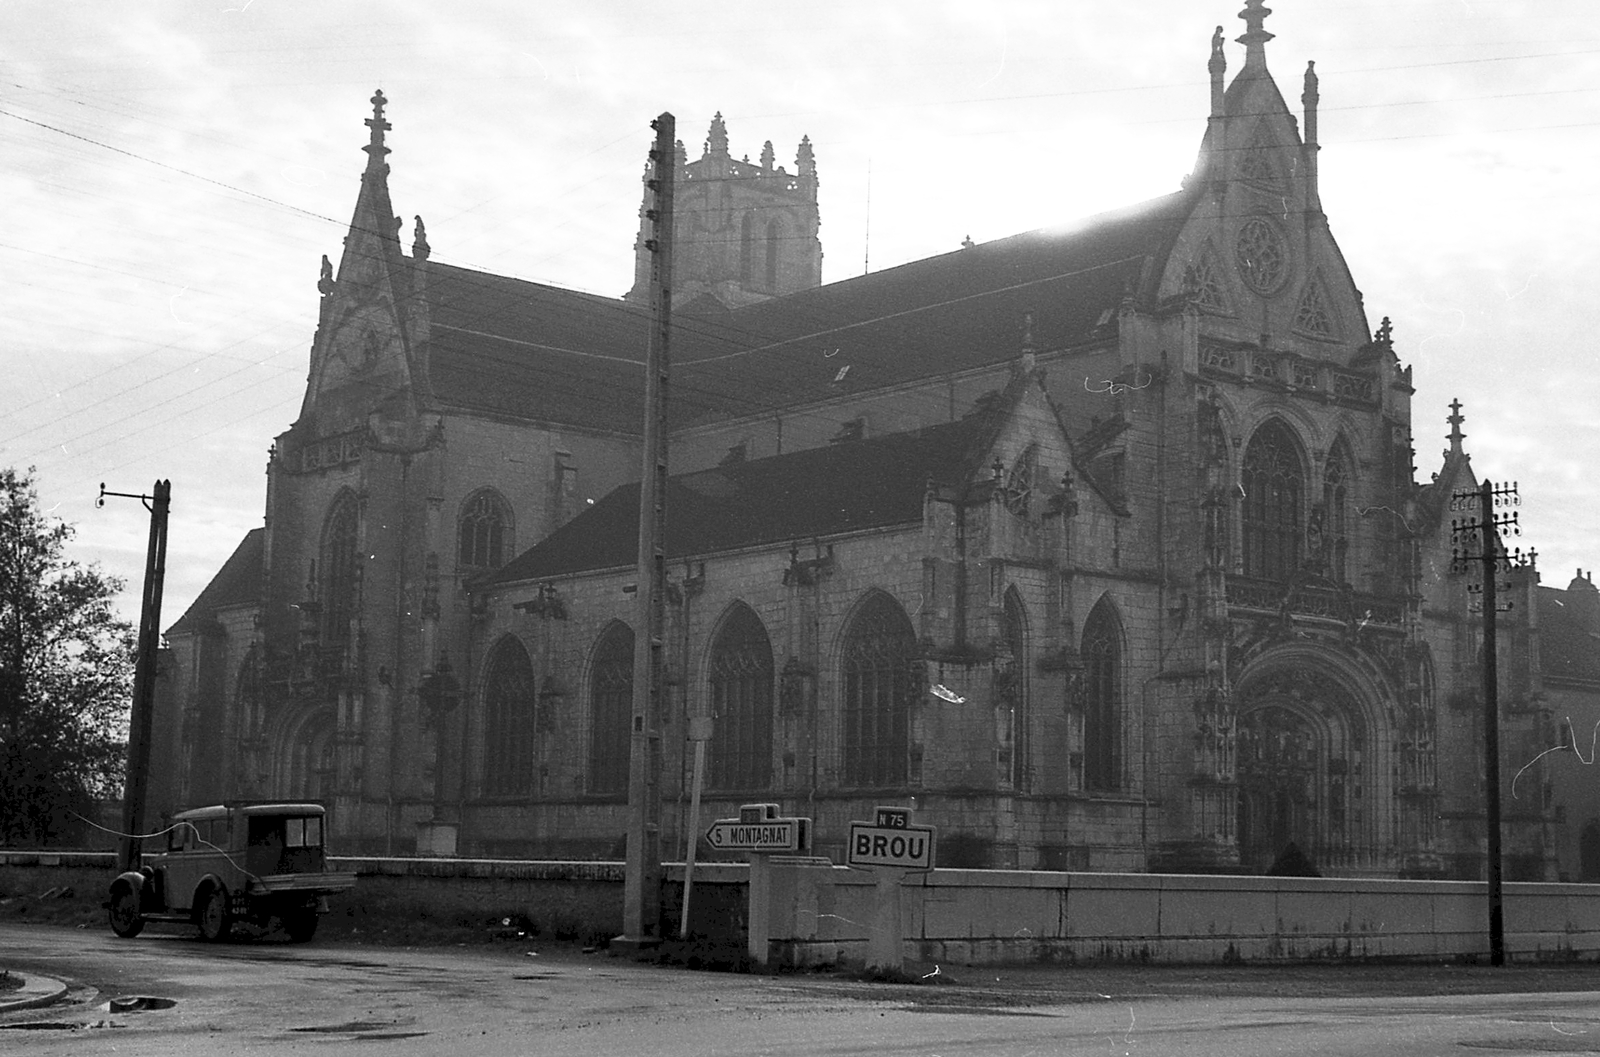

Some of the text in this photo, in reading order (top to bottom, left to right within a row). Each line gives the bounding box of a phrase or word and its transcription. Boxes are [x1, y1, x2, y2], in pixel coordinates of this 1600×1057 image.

[879, 814, 905, 827] N 75
[715, 826, 788, 844] 5 MONTAGNAT
[856, 833, 924, 860] BROU
